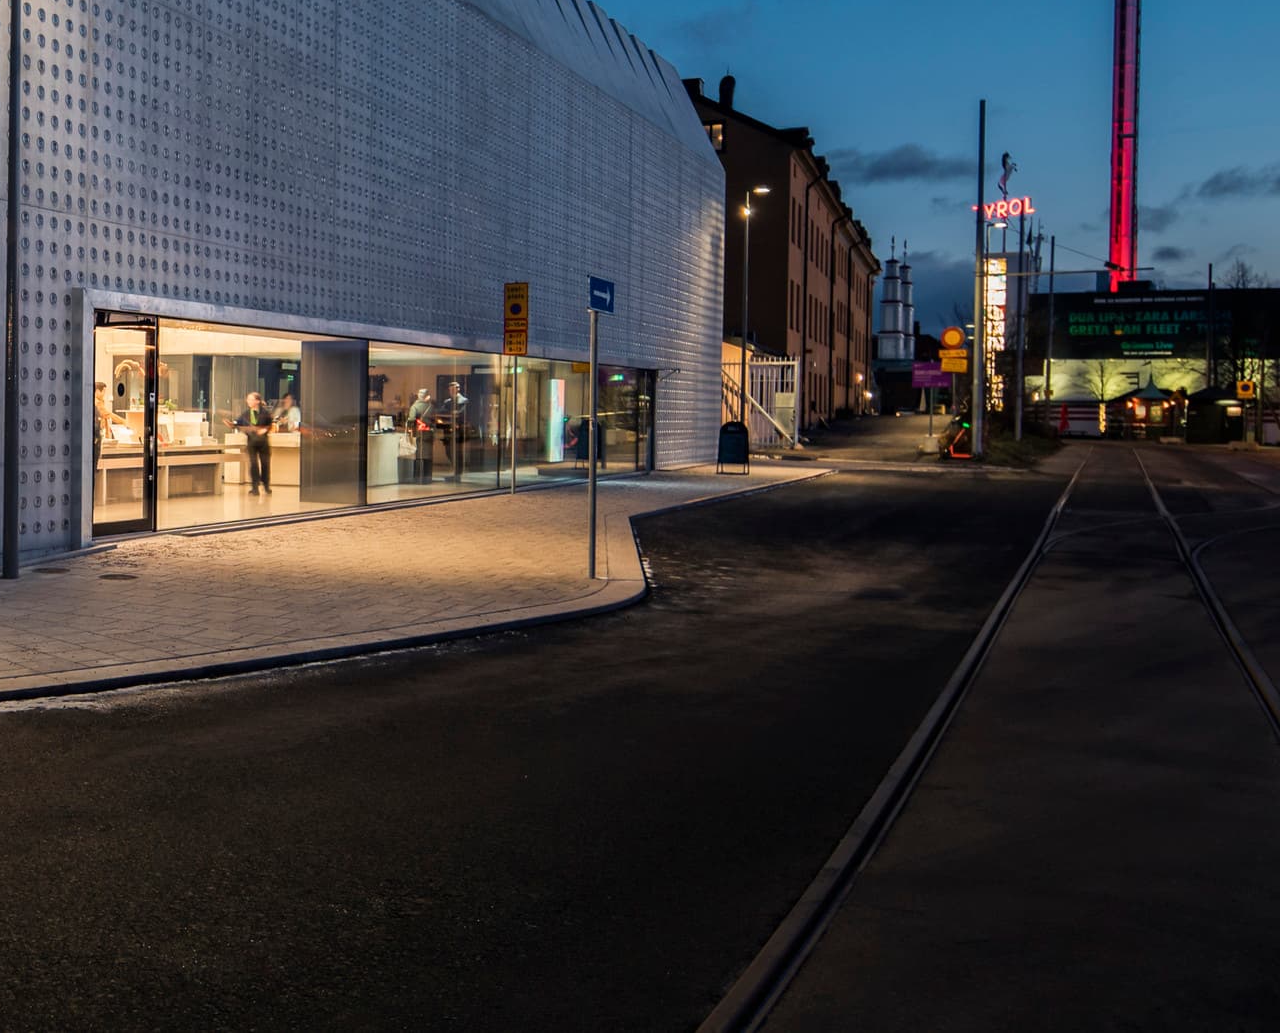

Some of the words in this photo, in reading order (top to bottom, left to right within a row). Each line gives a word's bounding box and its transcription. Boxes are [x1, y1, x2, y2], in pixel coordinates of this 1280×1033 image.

[972, 196, 1035, 219] YROL
[1068, 311, 1095, 323] DUA
[1135, 310, 1169, 322] ZARA
[1068, 324, 1110, 336] GRETA
[1145, 323, 1179, 335] FLEET
